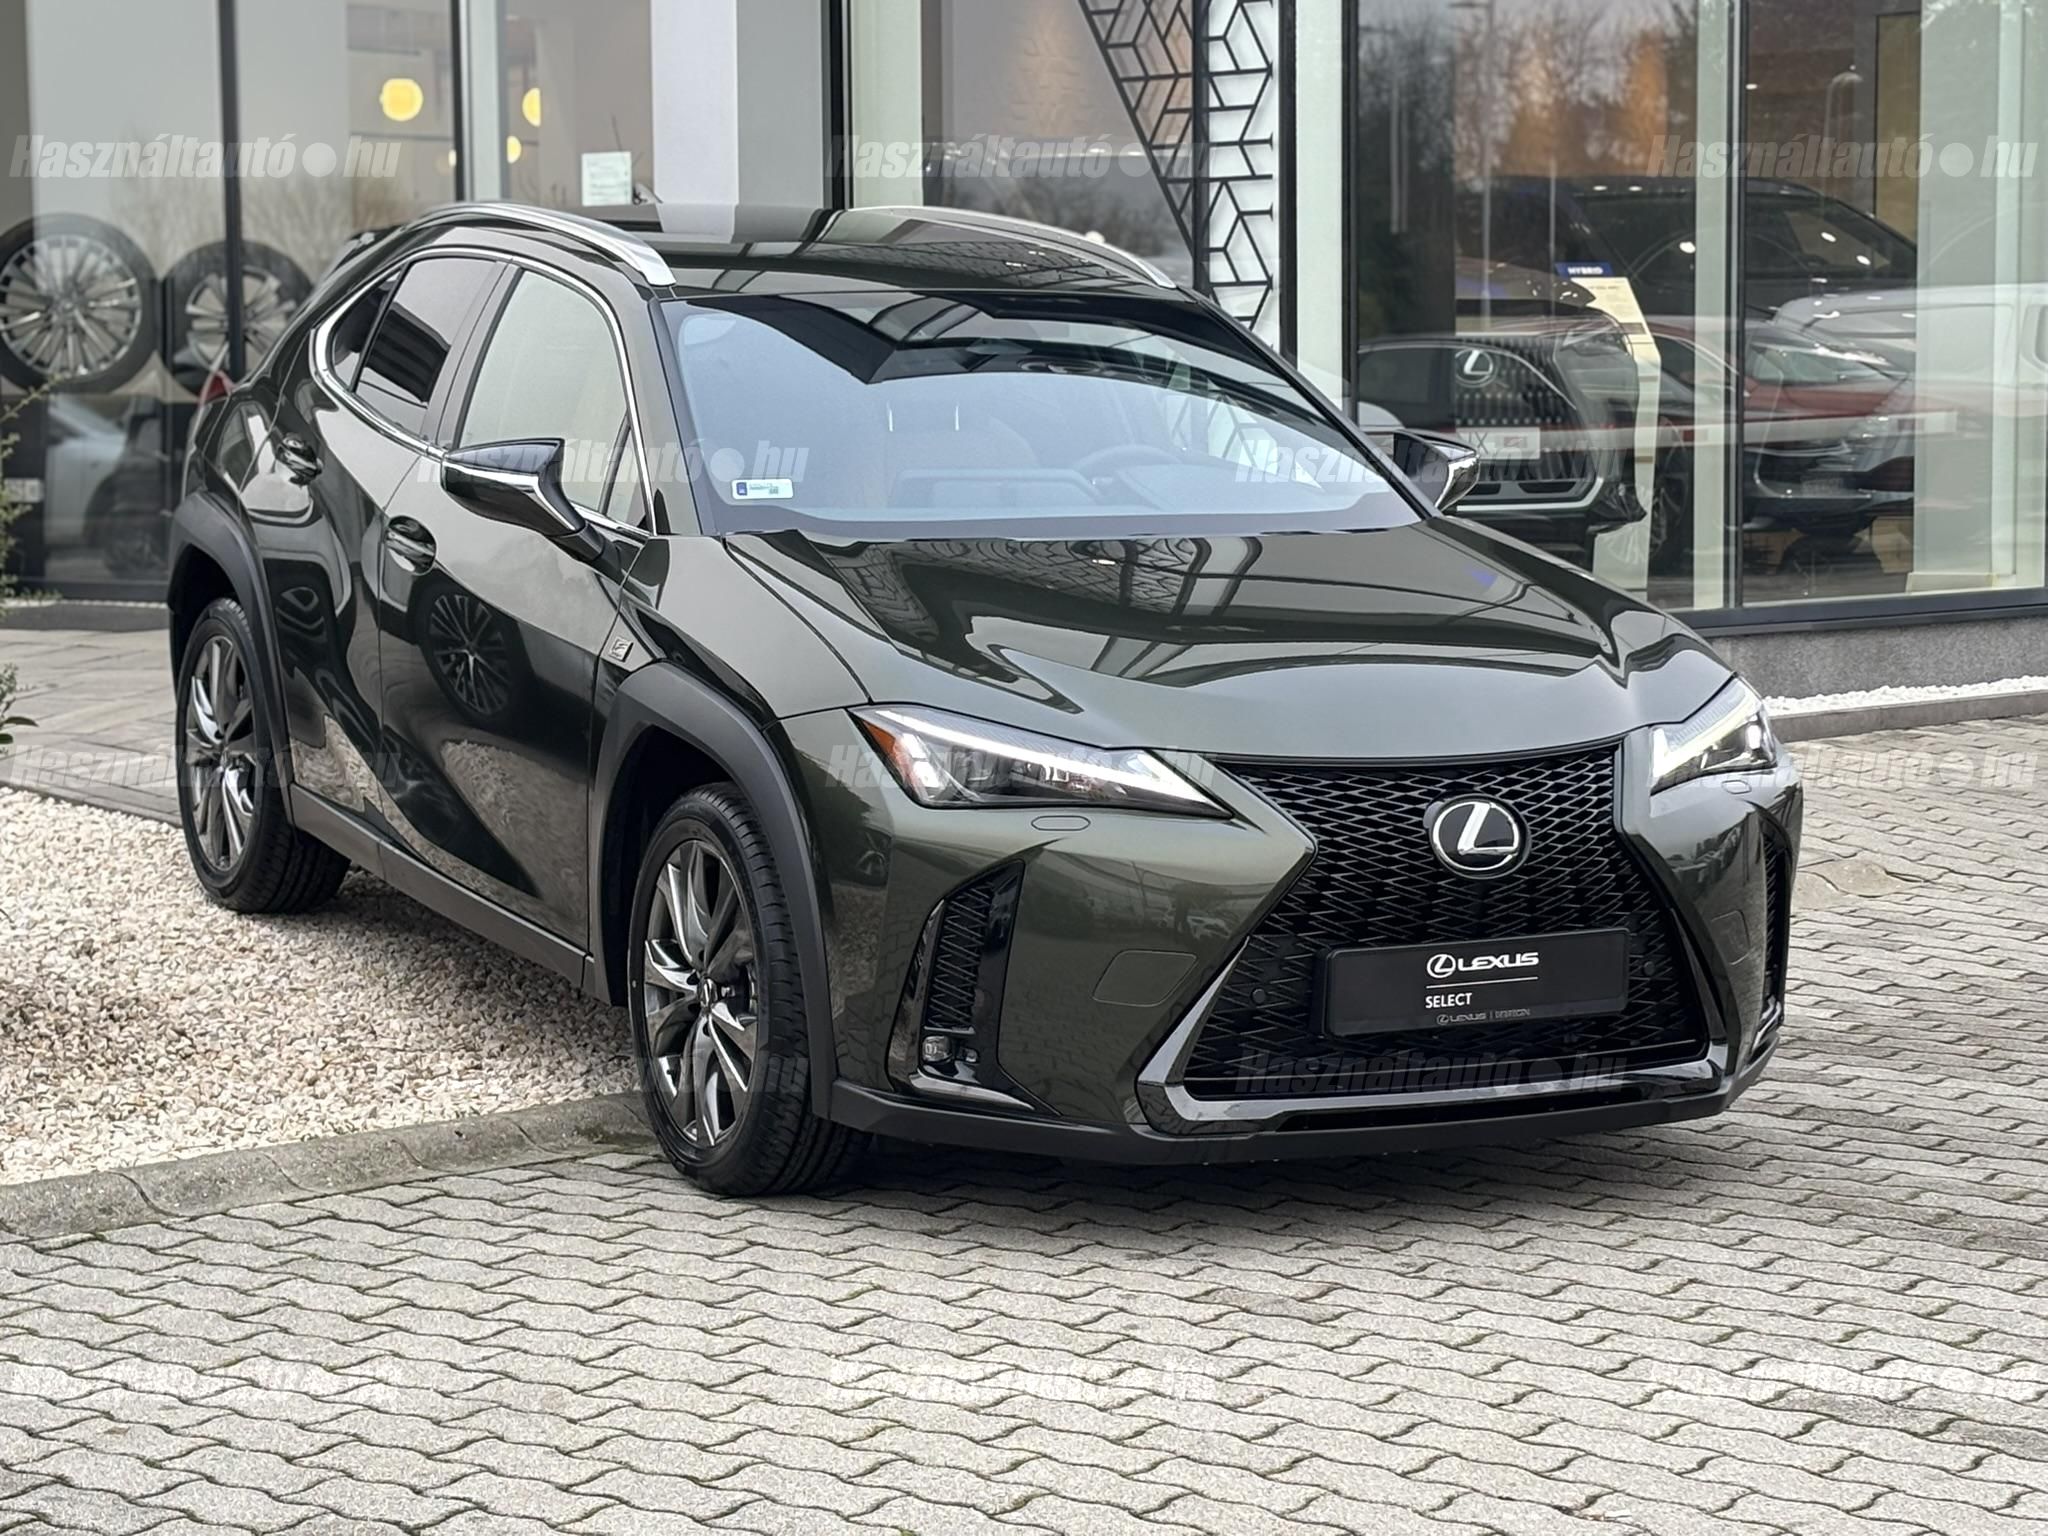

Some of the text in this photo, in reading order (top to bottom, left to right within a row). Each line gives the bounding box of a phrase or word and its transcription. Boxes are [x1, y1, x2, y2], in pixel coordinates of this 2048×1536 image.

[1458, 952, 1539, 971] LEXUS
[1425, 993, 1472, 1008] SELECT
[1450, 1012, 1486, 1022] LEXUS
